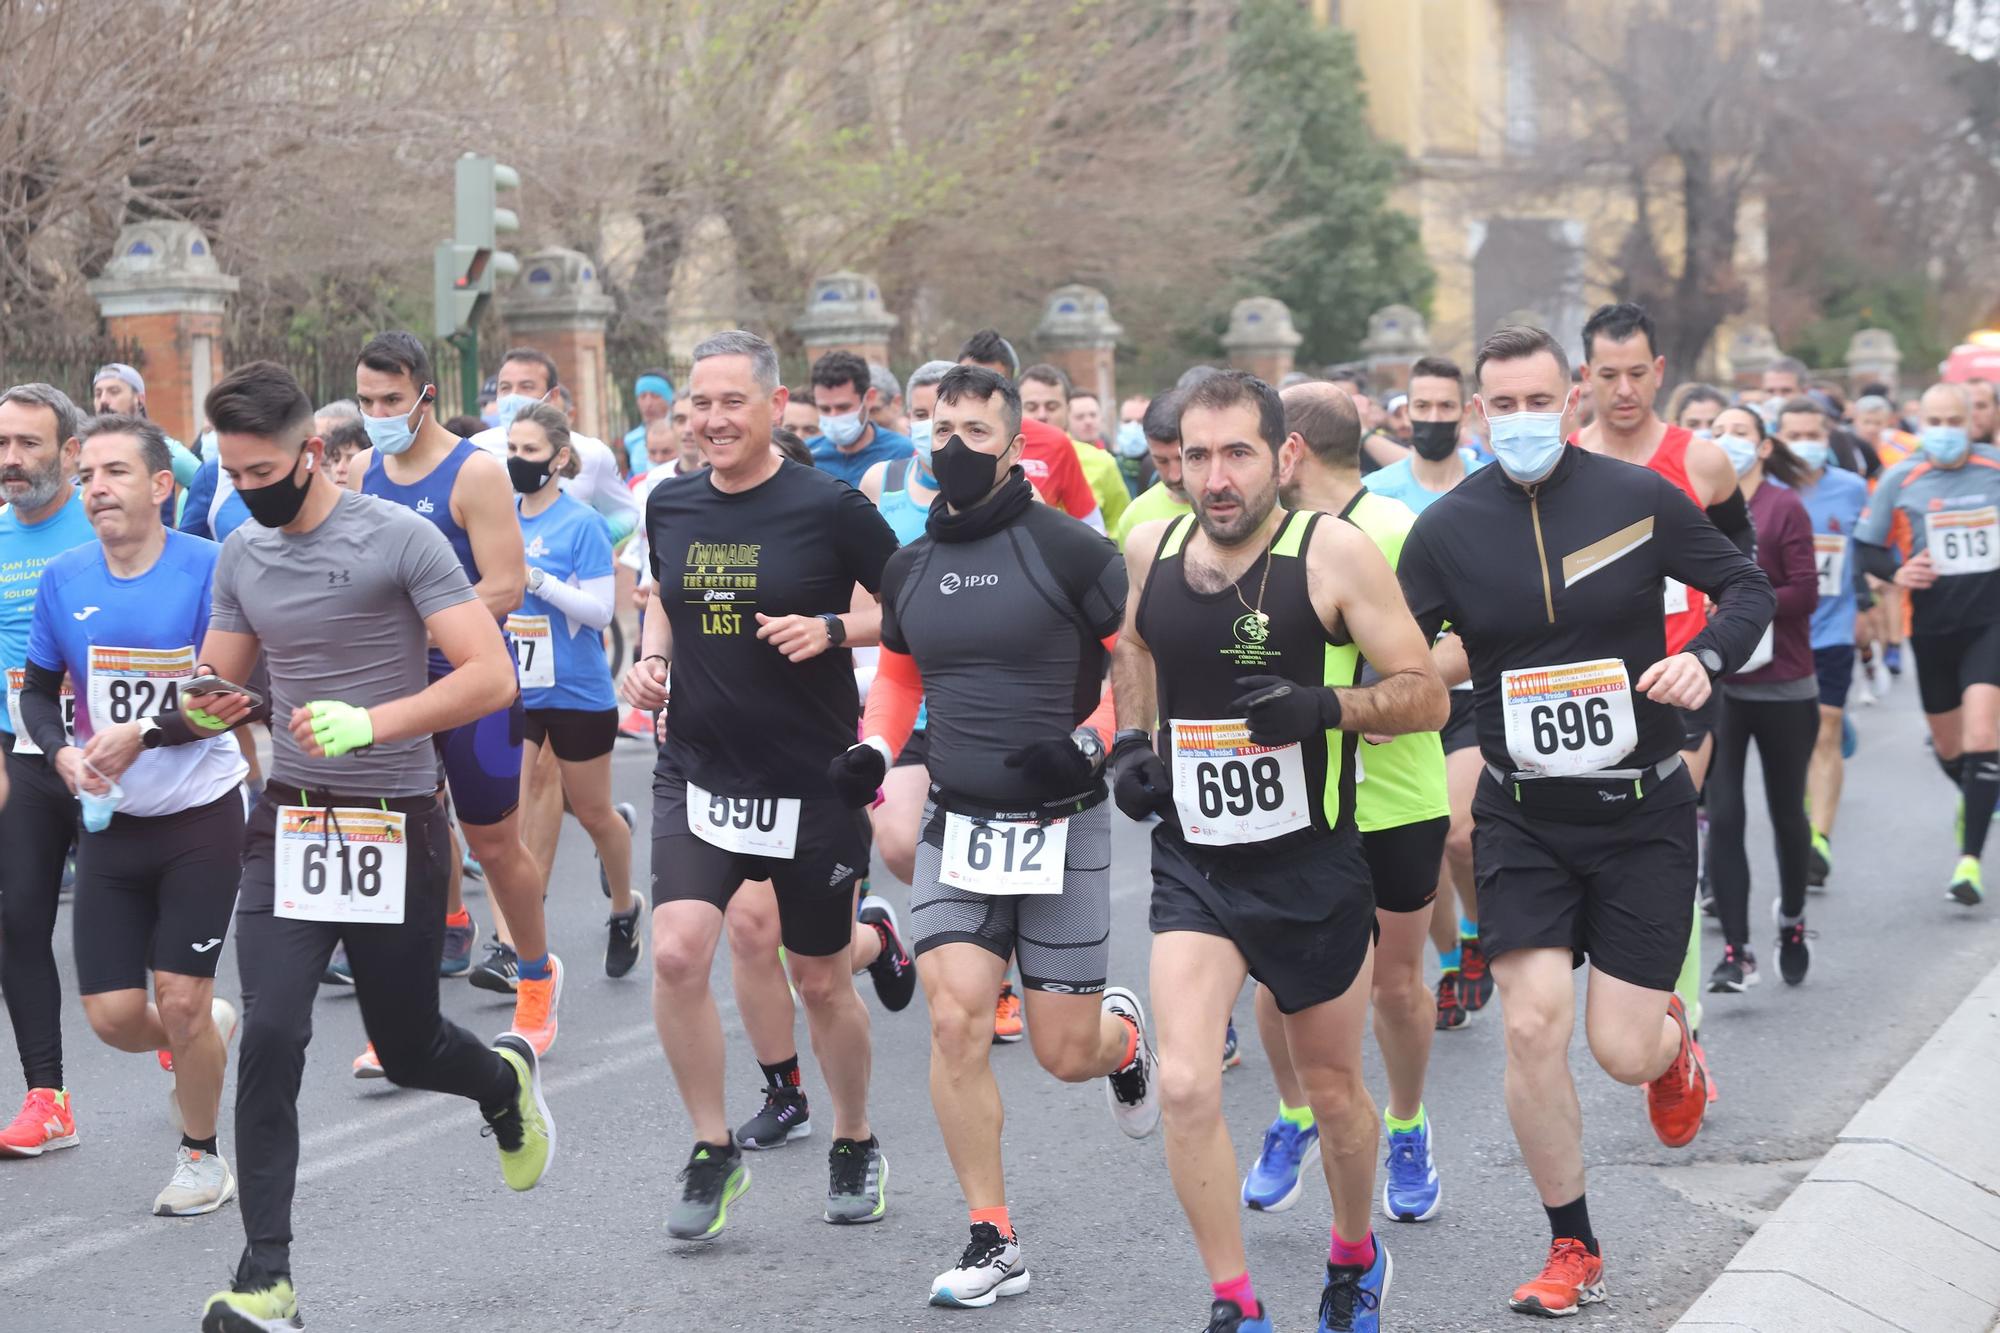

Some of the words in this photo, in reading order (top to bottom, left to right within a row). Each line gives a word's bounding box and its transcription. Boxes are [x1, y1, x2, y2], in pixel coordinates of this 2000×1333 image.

[1944, 530, 1989, 560] 613
[2, 560, 23, 572] SAN
[965, 574, 999, 588] iPSO
[683, 576, 702, 588] THE
[704, 576, 733, 588] NEXT
[735, 576, 757, 588] RUN
[714, 591, 735, 601] asics
[701, 613, 742, 635] LAST
[110, 679, 179, 724] 824
[1572, 681, 1626, 697] TRINITARIOS
[1530, 697, 1614, 755] 696
[1197, 756, 1285, 819] 698
[708, 794, 778, 833] 590
[967, 826, 1046, 874] 612
[302, 843, 382, 897] 618
